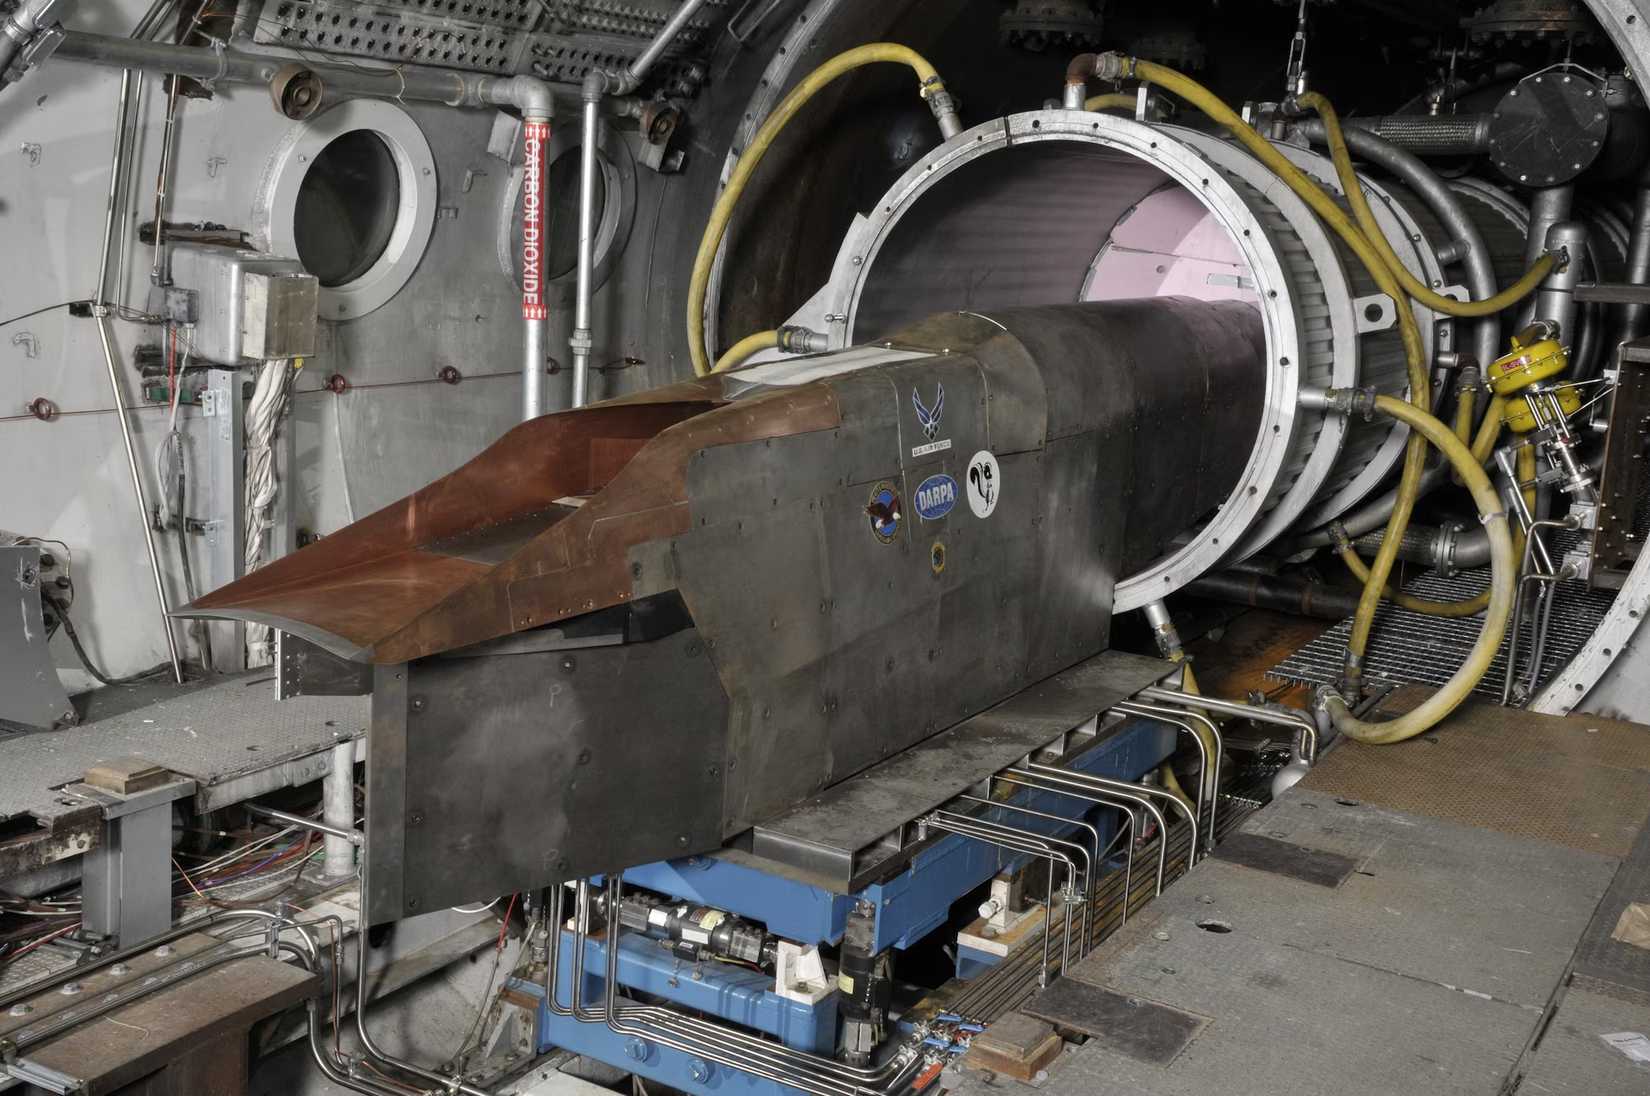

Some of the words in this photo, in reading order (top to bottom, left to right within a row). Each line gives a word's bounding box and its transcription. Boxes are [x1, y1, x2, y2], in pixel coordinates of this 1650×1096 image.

[523, 138, 540, 222] CARBON
[523, 228, 539, 304] DIOXIDE
[919, 482, 954, 511] DARPA
